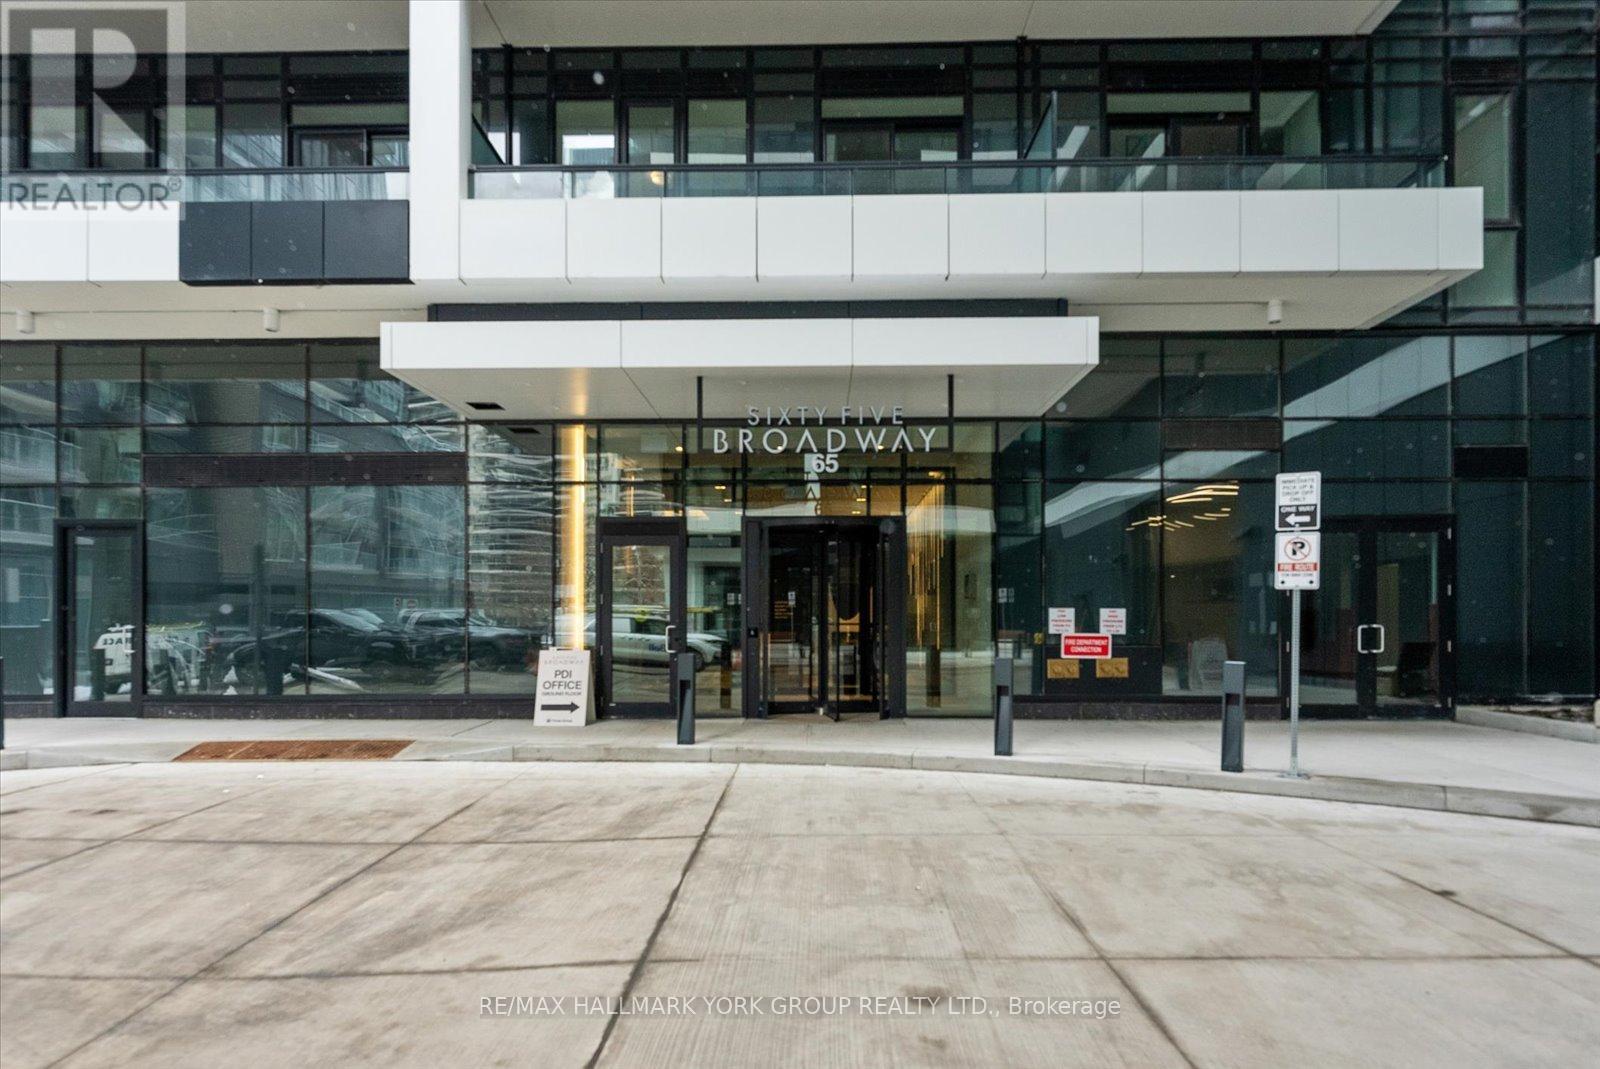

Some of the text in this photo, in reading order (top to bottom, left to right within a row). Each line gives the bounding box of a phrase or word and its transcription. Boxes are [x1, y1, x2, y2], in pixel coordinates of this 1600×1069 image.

[747, 406, 904, 426] SIXTY FIVE
[713, 427, 937, 454] BROADWAY
[811, 453, 840, 473] 65
[1076, 638, 1108, 646] DEPARTMENT
[554, 669, 573, 679] PDI
[542, 680, 583, 690] OFFICE
